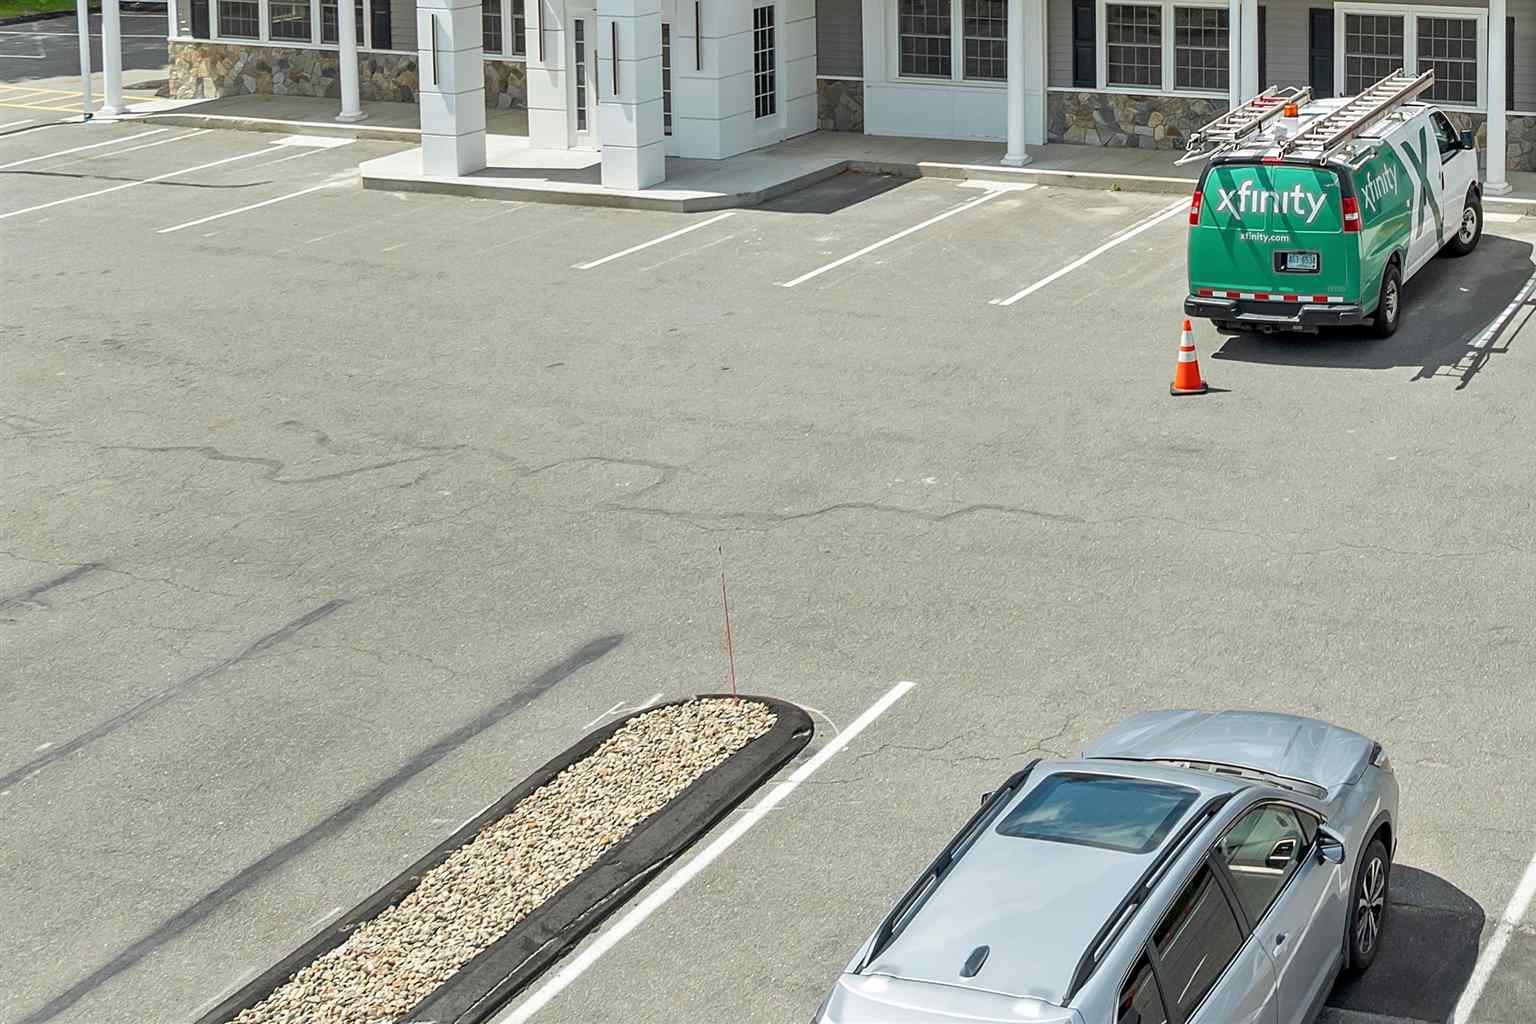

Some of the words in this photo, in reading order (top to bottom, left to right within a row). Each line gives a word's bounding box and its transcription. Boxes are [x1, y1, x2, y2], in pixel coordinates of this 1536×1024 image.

[1216, 179, 1328, 224] xfinity
[1361, 162, 1399, 212] xfinity
[1239, 232, 1290, 243] xfinity.com
